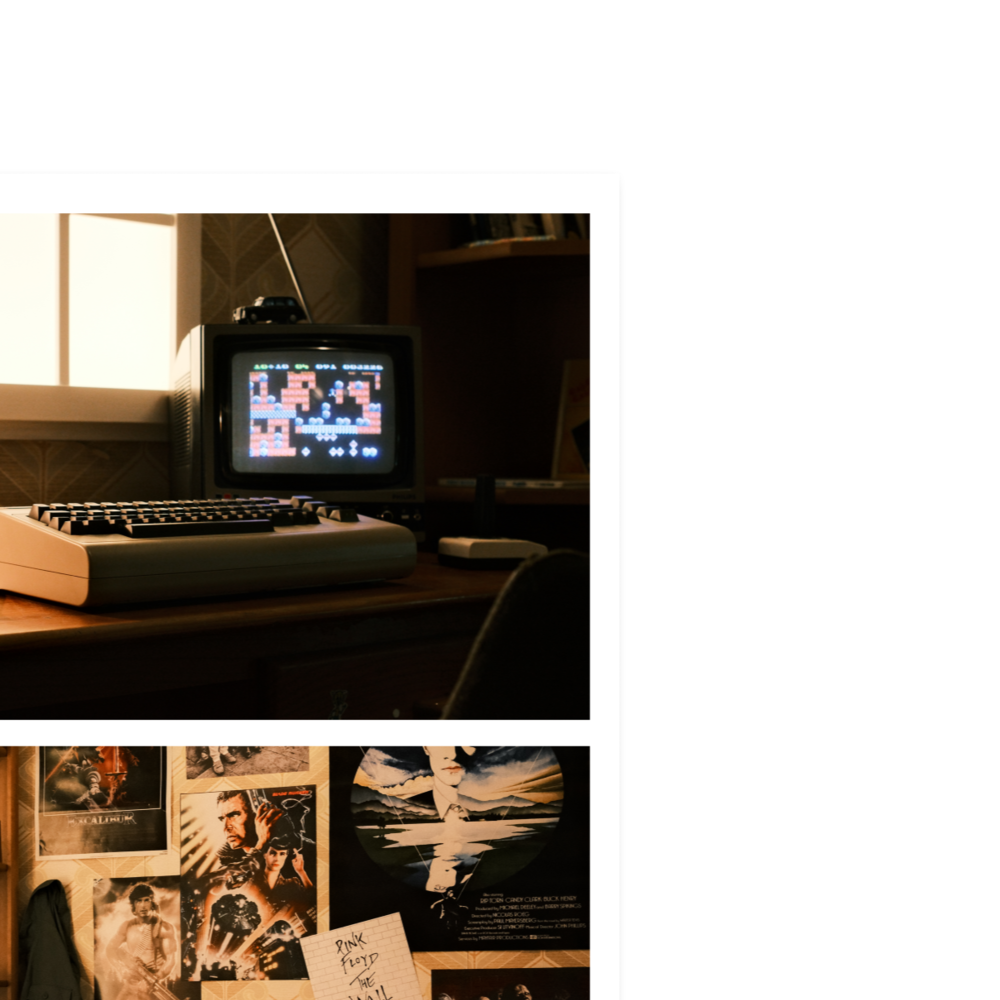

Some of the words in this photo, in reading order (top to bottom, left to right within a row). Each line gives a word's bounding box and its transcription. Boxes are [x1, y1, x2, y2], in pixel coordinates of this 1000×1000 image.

[66, 812, 137, 826] EXCALIBUR
[335, 931, 367, 955] PINK
[341, 951, 379, 974] FLOYD
[349, 968, 376, 991] THE
